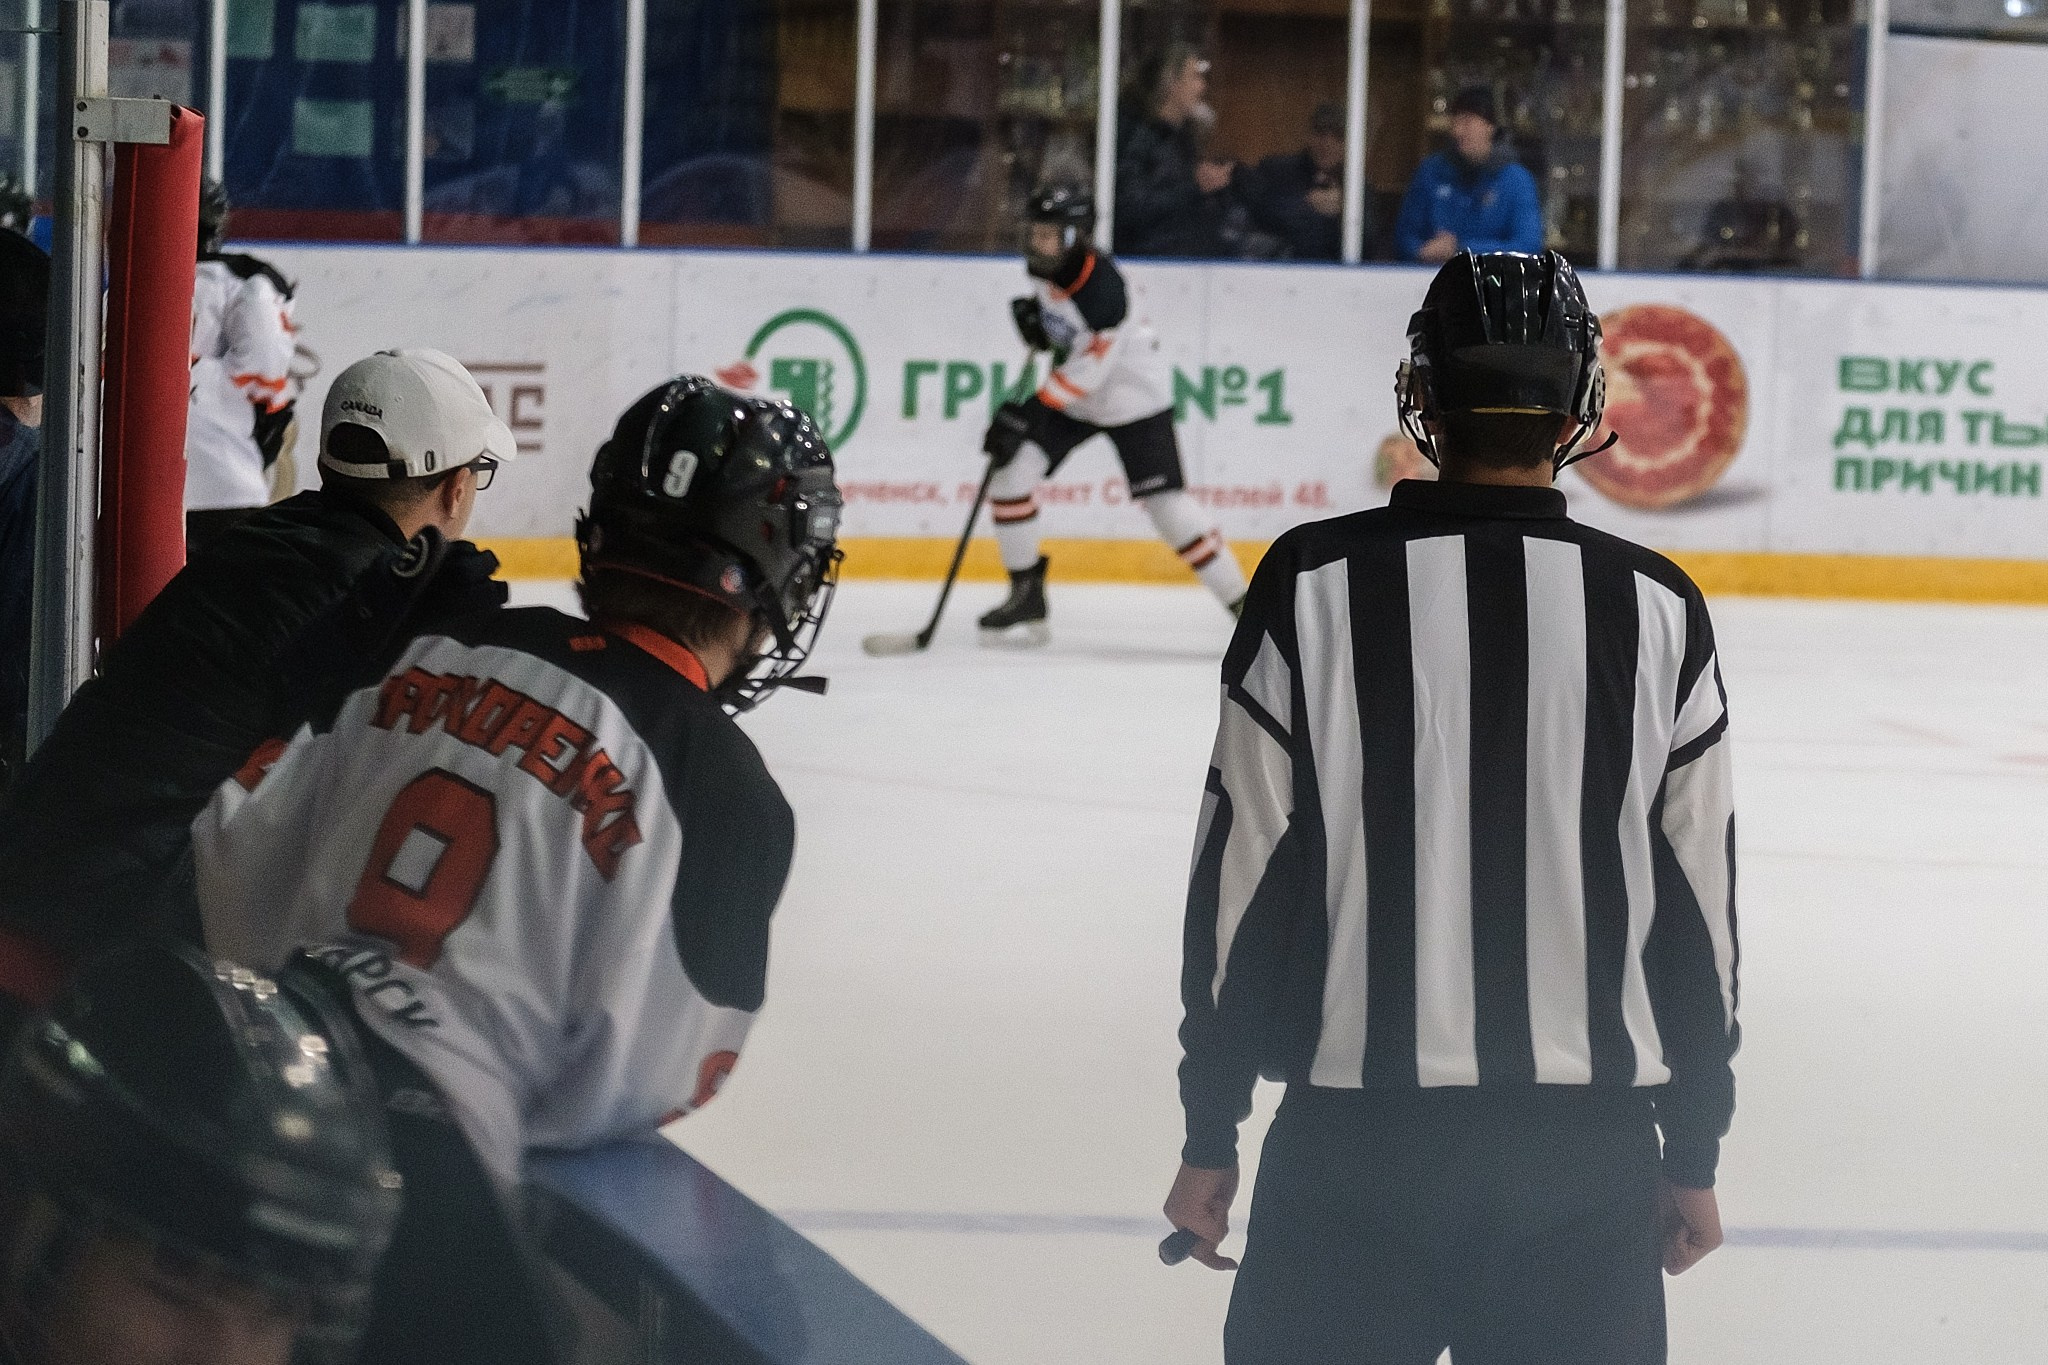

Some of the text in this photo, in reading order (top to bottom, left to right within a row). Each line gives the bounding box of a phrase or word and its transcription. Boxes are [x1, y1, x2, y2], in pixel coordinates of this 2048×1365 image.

[1171, 363, 1294, 425] №1
[1837, 355, 1994, 396] ВКУС
[340, 399, 384, 421] CANADA
[1832, 405, 1945, 450] ДЛЯ
[662, 449, 699, 498] 9
[1832, 455, 2043, 498] ПРИЧИН
